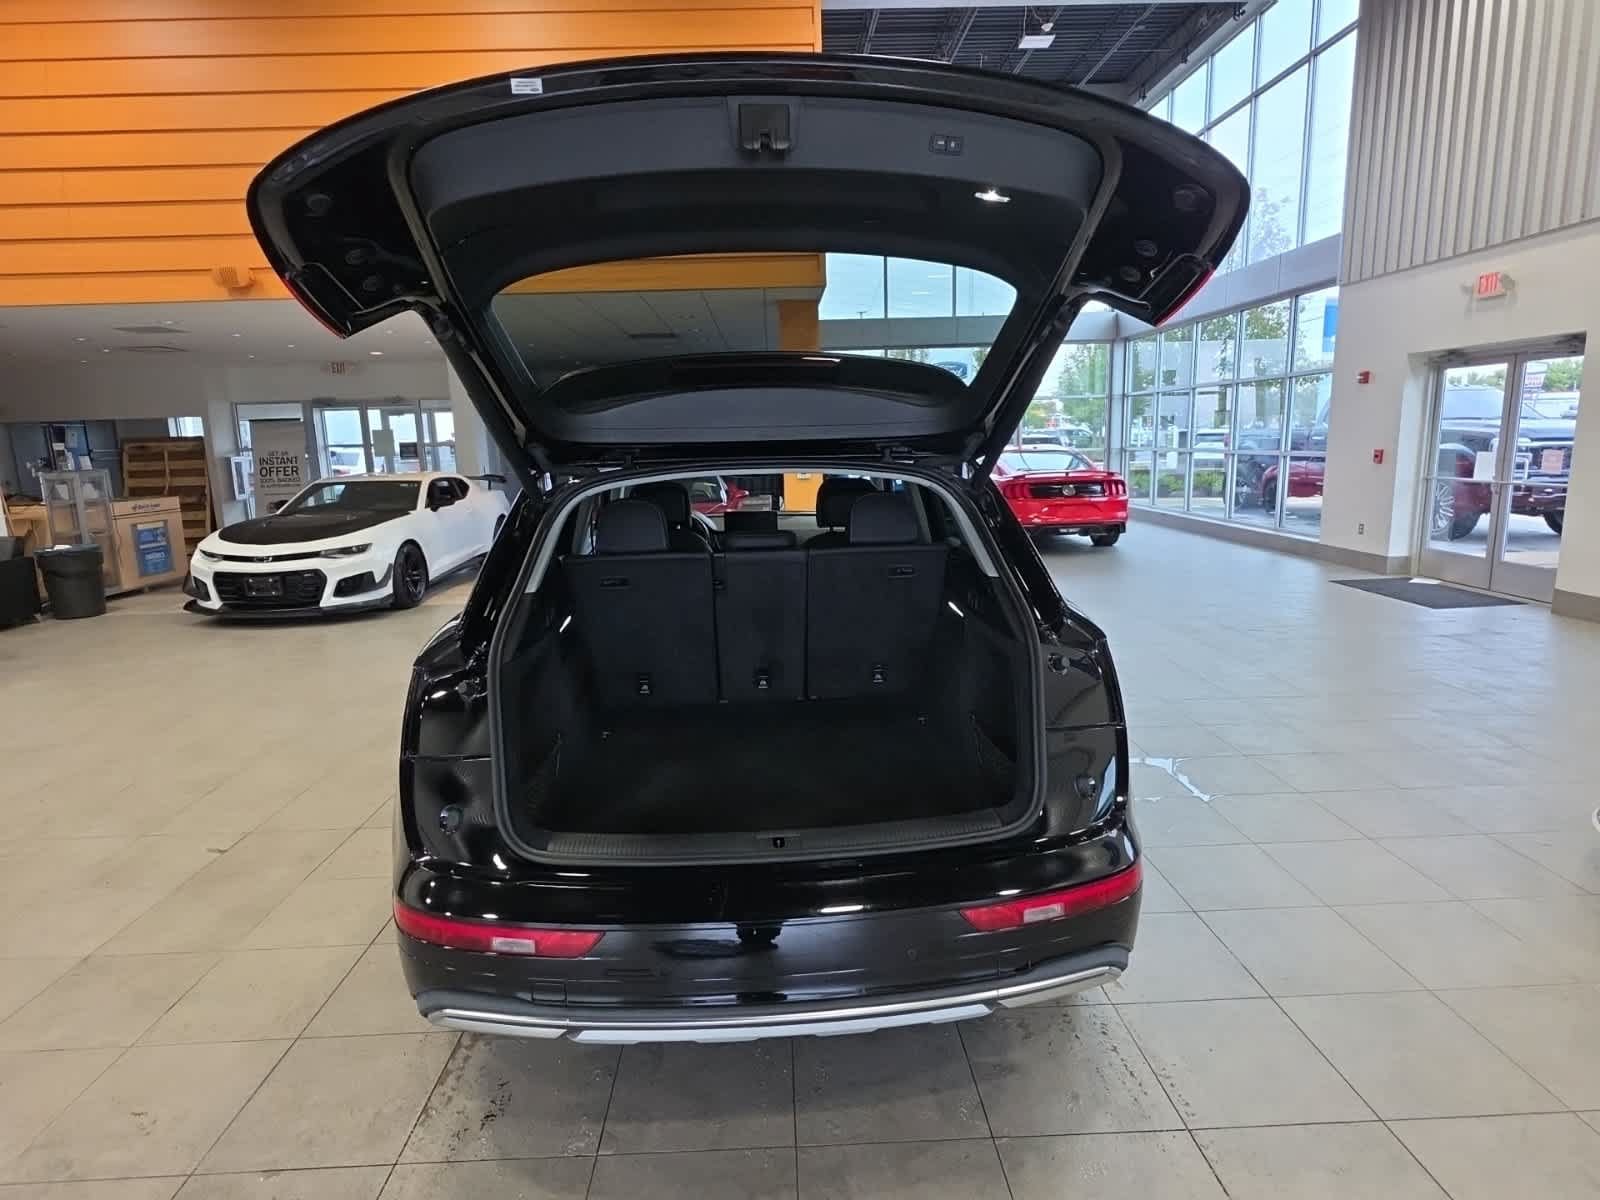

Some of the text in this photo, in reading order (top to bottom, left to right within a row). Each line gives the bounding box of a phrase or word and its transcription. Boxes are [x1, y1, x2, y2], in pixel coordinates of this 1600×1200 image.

[1478, 273, 1499, 295] EXIT
[259, 456, 298, 466] INSTANT
[259, 466, 299, 477] OFFER
